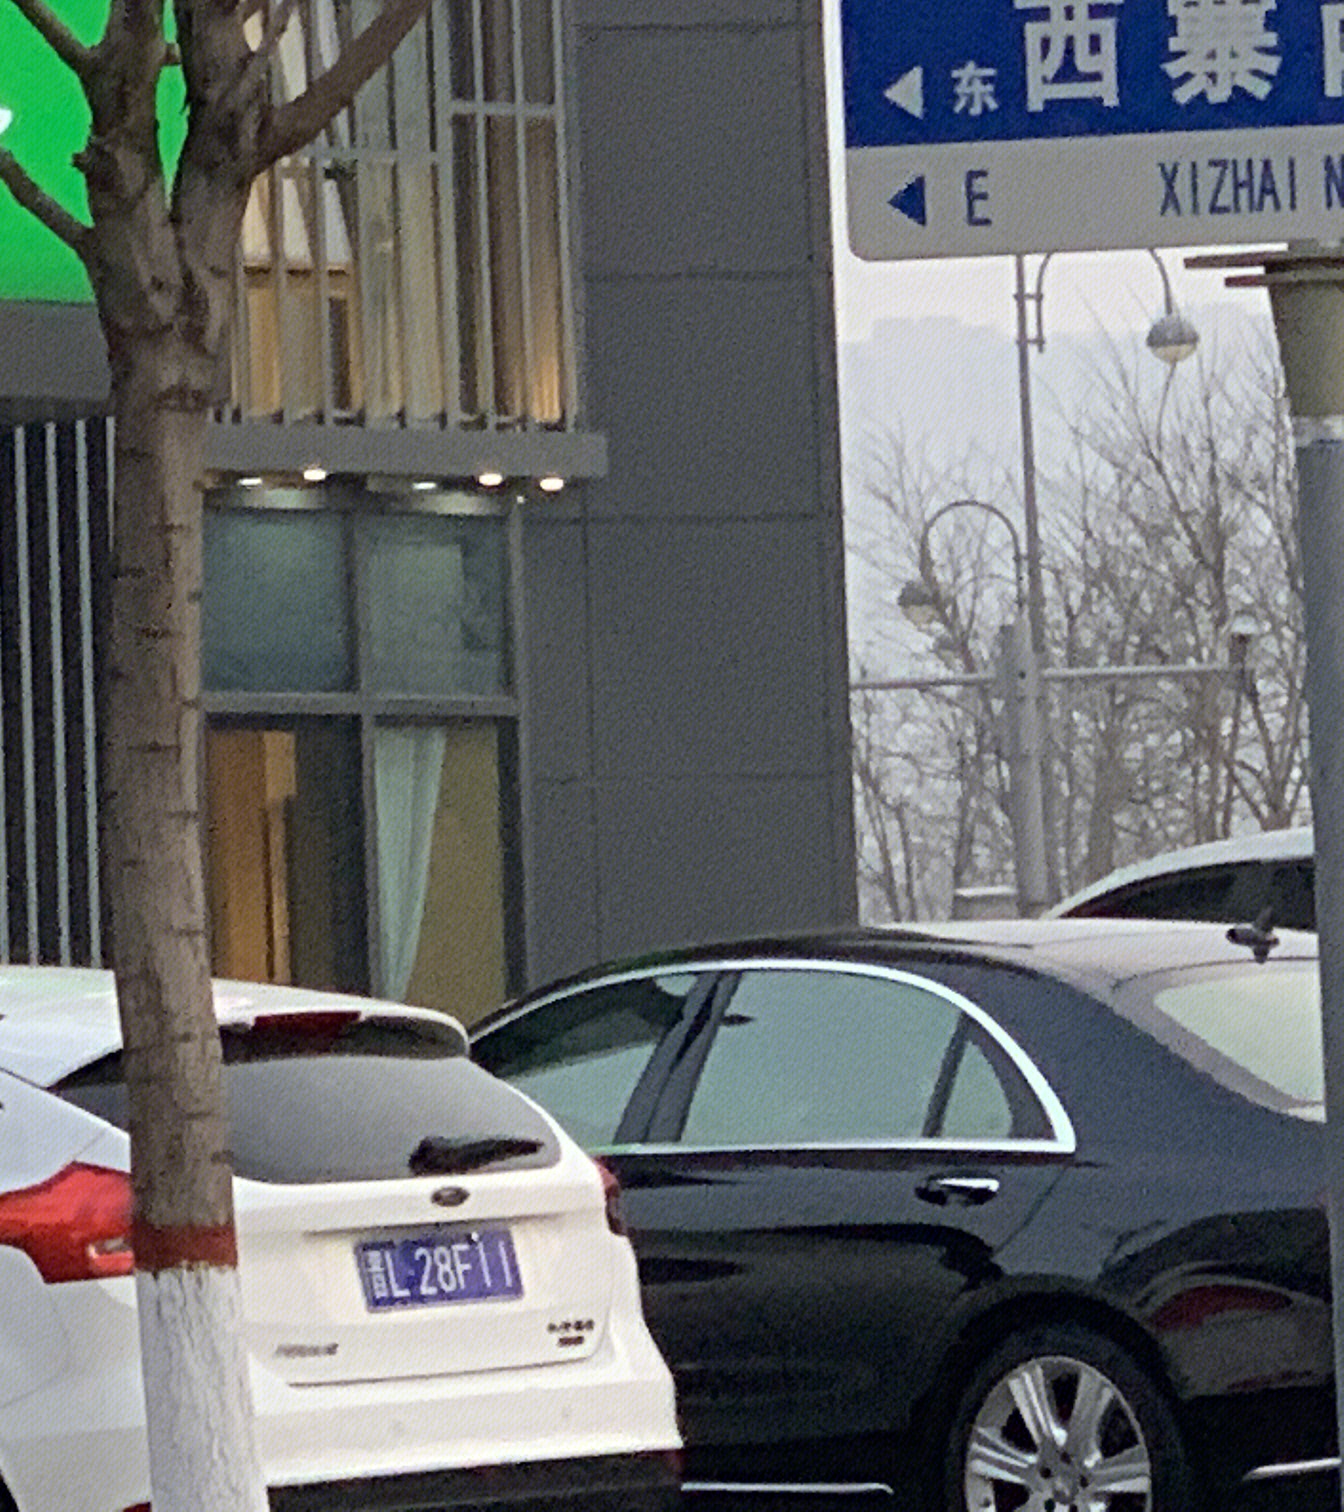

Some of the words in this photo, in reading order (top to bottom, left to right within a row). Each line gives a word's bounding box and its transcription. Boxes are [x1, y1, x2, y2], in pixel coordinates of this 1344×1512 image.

[951, 60, 999, 116] 东
[965, 169, 992, 226] E
[1158, 156, 1297, 216] XIZHAI
